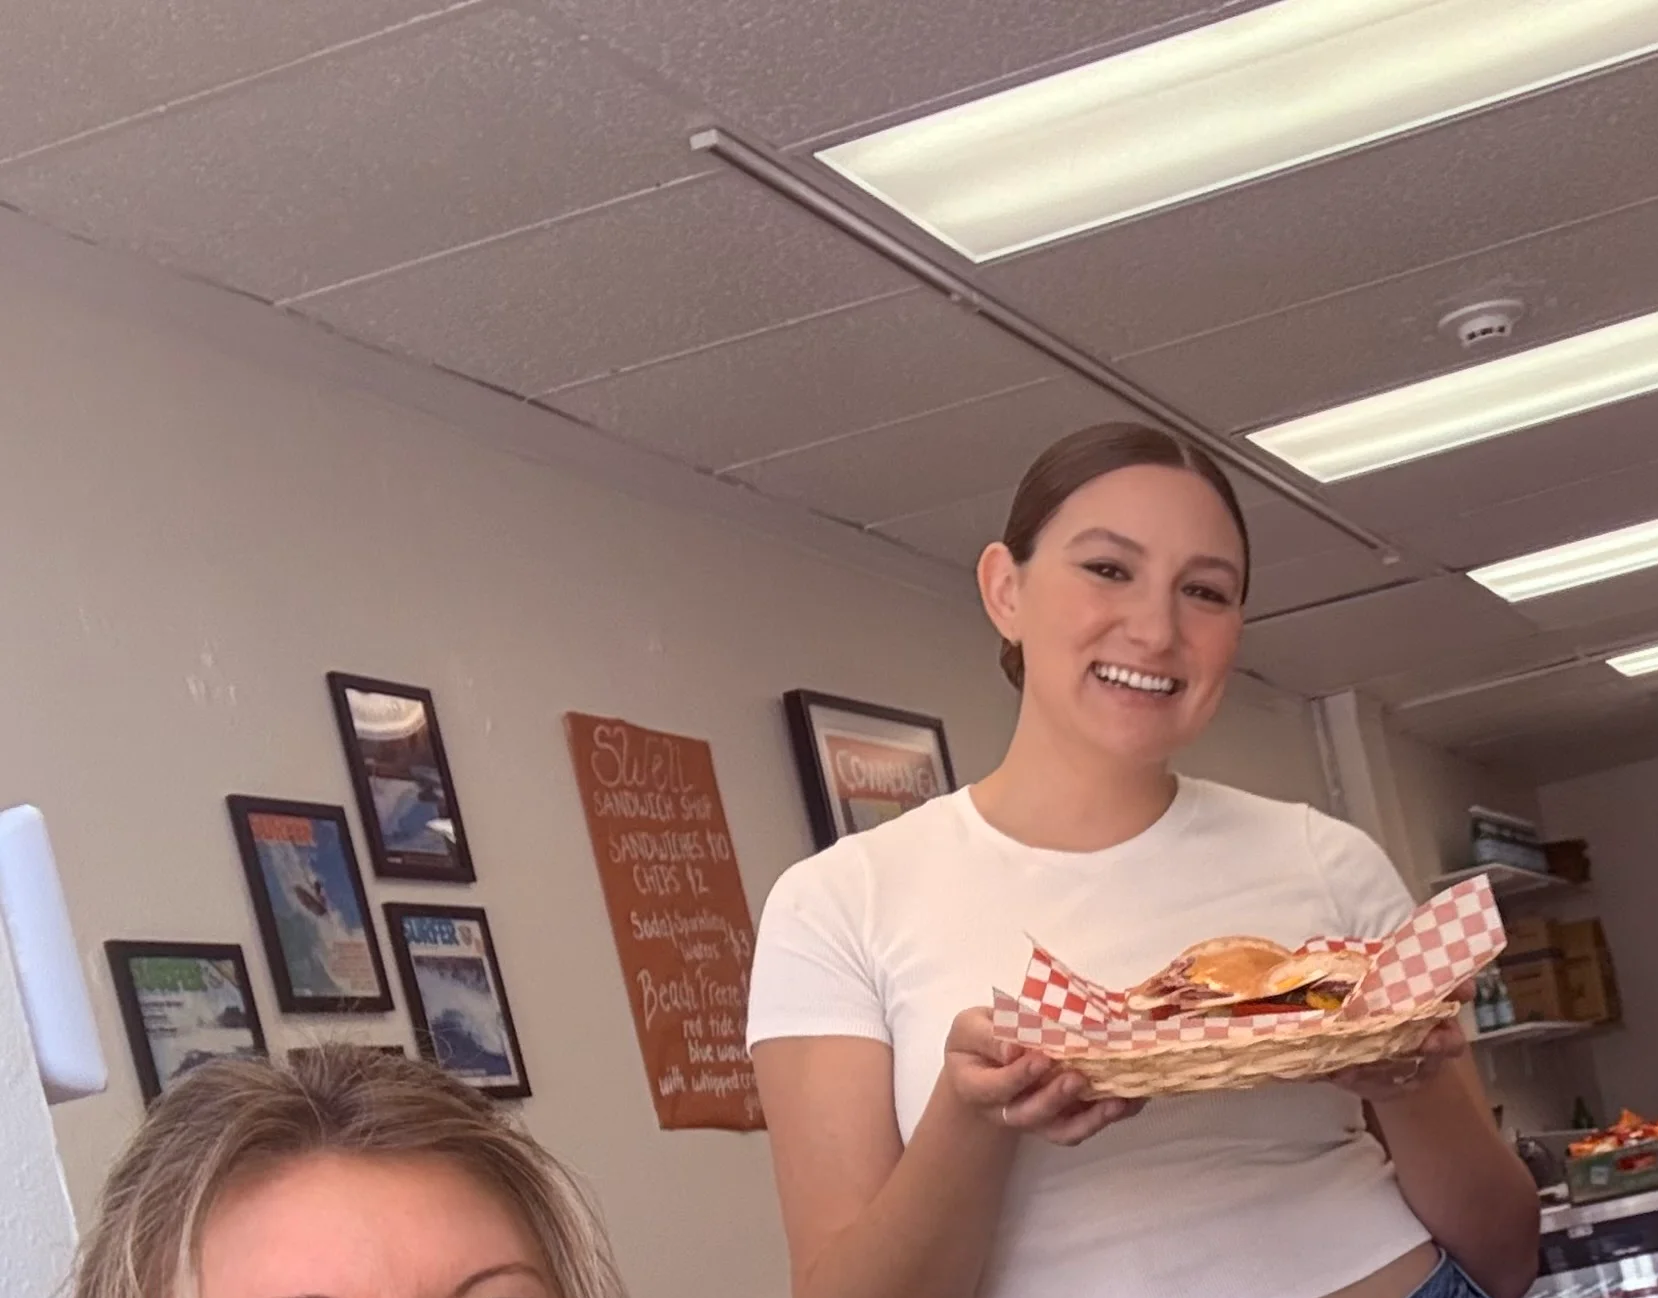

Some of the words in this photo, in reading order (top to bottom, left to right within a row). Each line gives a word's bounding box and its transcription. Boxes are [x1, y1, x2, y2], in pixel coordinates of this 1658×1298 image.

[593, 790, 677, 823] SANDWICH
[607, 828, 705, 864] SANDWICHES
[705, 827, 730, 865] $10
[632, 862, 681, 896] CHIPS
[685, 861, 710, 899] $2
[726, 920, 750, 966] $3
[636, 968, 699, 1032] Beach
[682, 1012, 703, 1040] red
[708, 1010, 735, 1038] tide
[687, 1038, 715, 1065] blue
[658, 1064, 687, 1098] with
[691, 1066, 740, 1098] whipped
